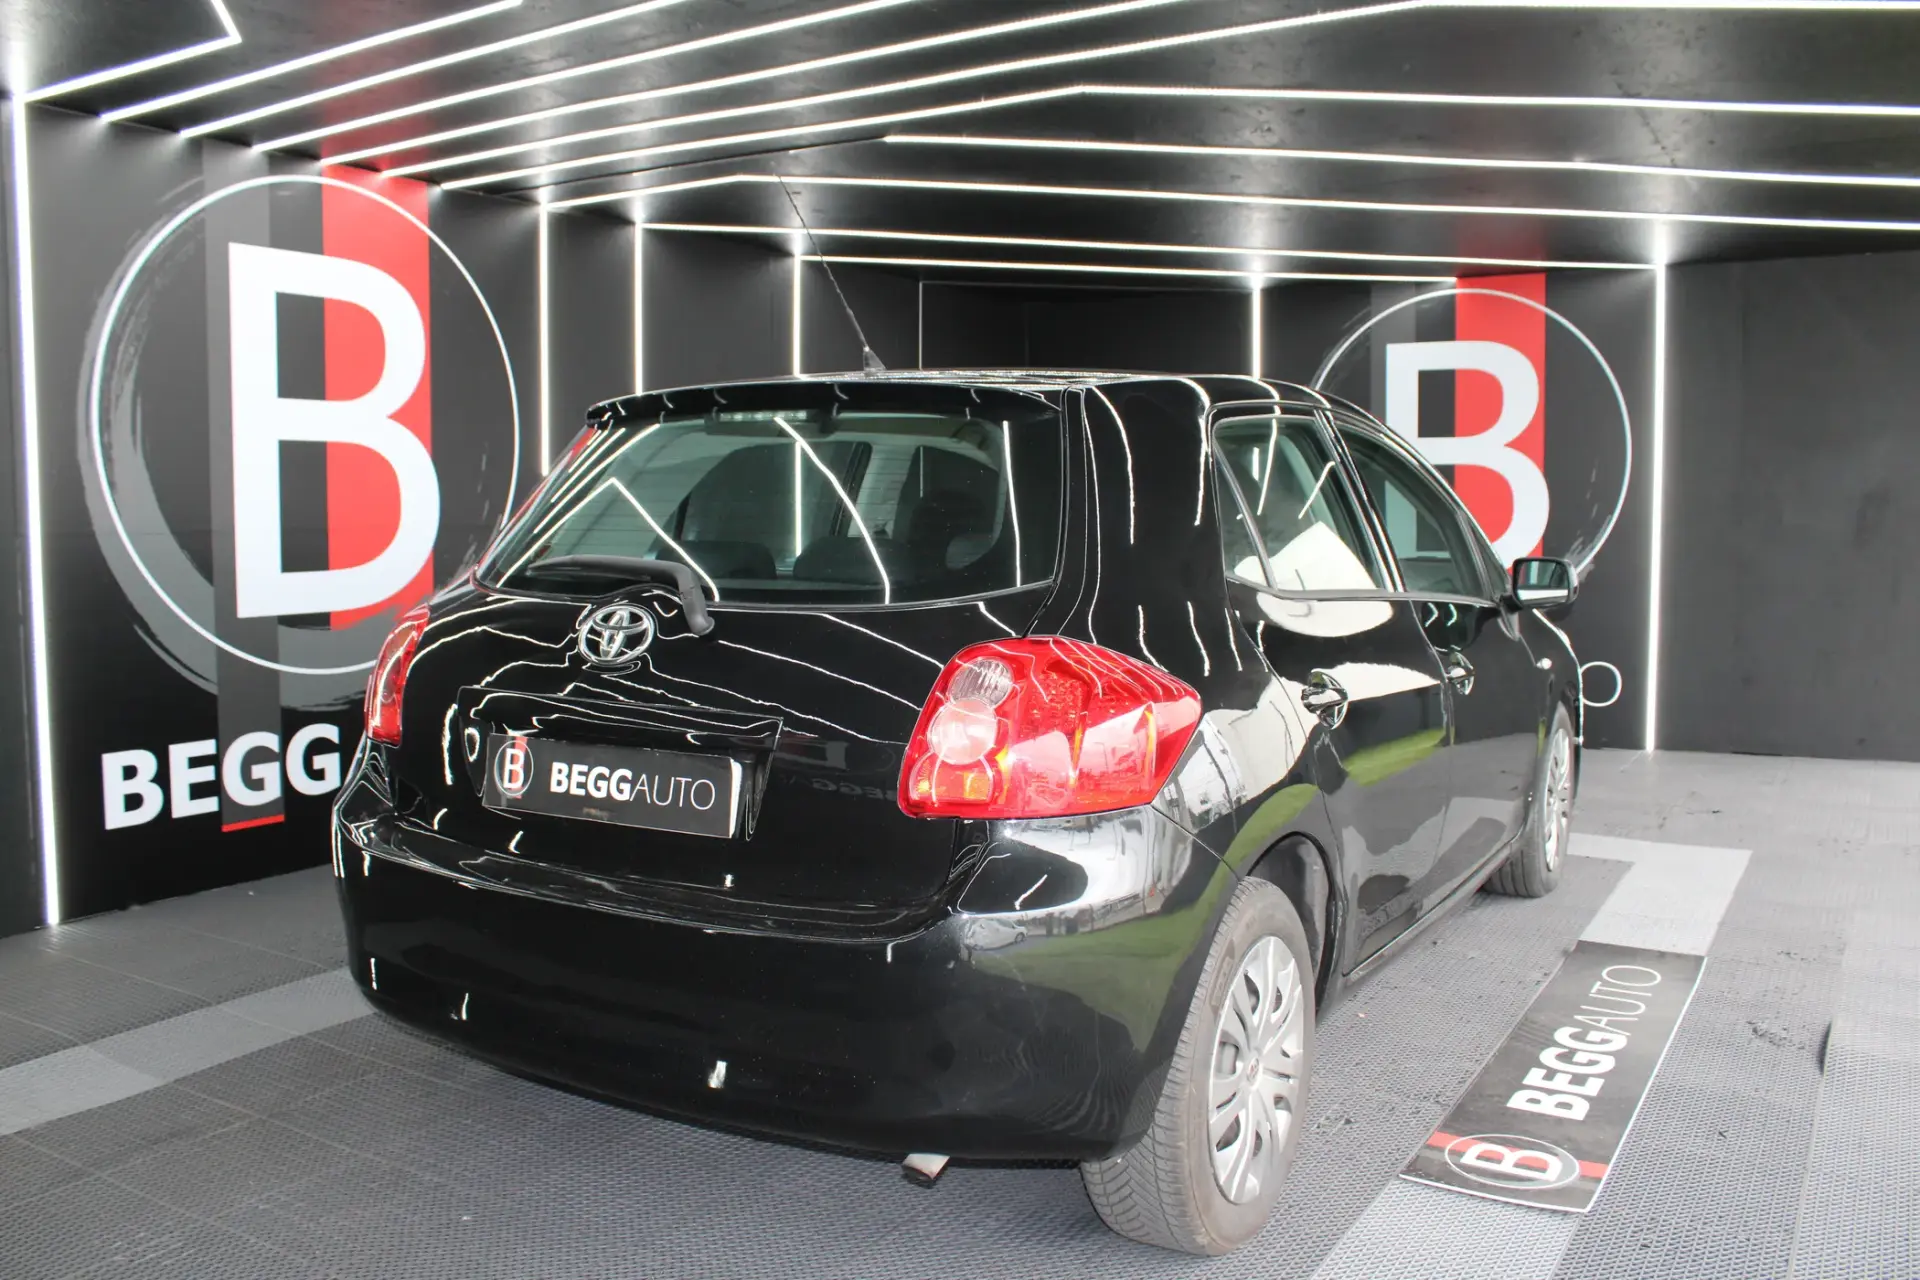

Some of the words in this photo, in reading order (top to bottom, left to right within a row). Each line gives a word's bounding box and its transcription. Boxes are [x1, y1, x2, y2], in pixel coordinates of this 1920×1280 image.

[229, 243, 440, 618] B
[1385, 340, 1549, 573] B
[102, 724, 341, 830] BEGG
[503, 749, 525, 789] B
[551, 762, 716, 810] BEGGAUTO
[1507, 965, 1662, 1120] BEGGAUTO
[1459, 1143, 1563, 1181] B
